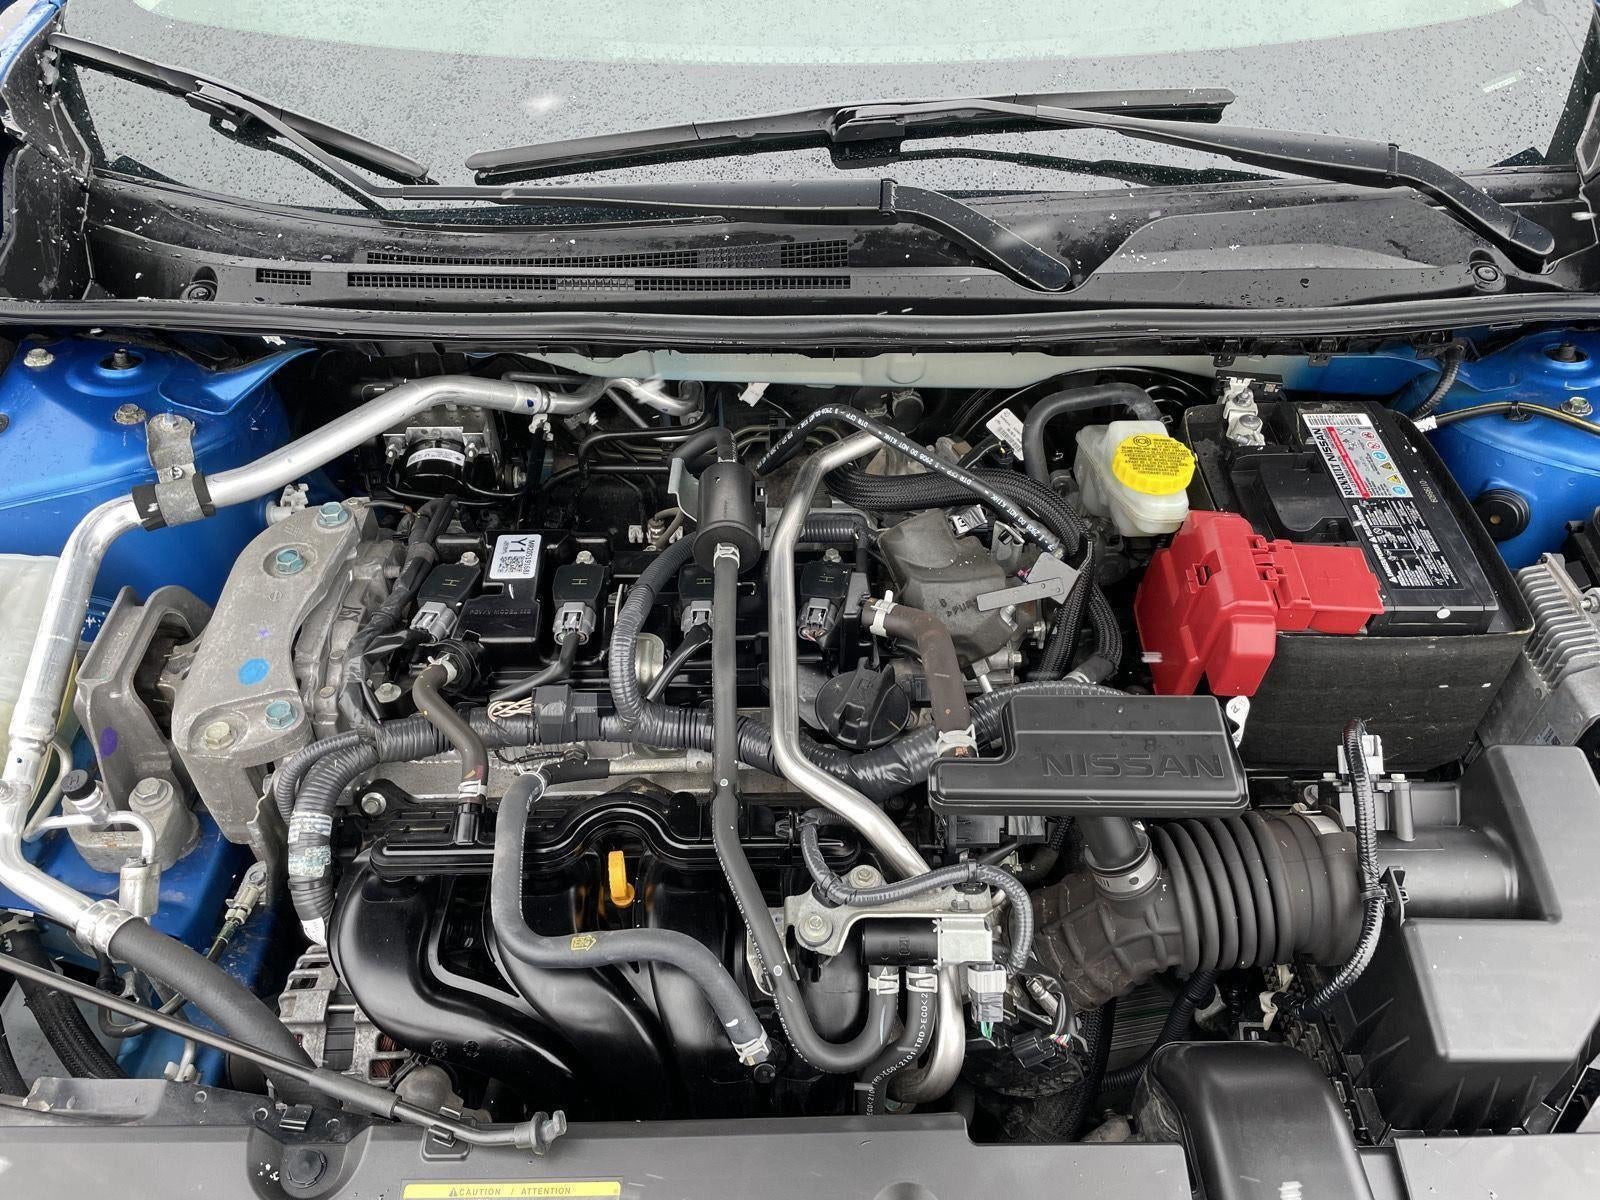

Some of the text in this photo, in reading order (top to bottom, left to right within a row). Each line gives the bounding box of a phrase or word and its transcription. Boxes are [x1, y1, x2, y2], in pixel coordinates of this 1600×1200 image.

[1312, 428, 1337, 462] NISSAN
[1330, 464, 1355, 497] RENAULT
[509, 538, 528, 552] Y1
[1039, 747, 1226, 782] NISSAN
[459, 1186, 501, 1197] CAUTION
[520, 1185, 571, 1196] ATTENTION
